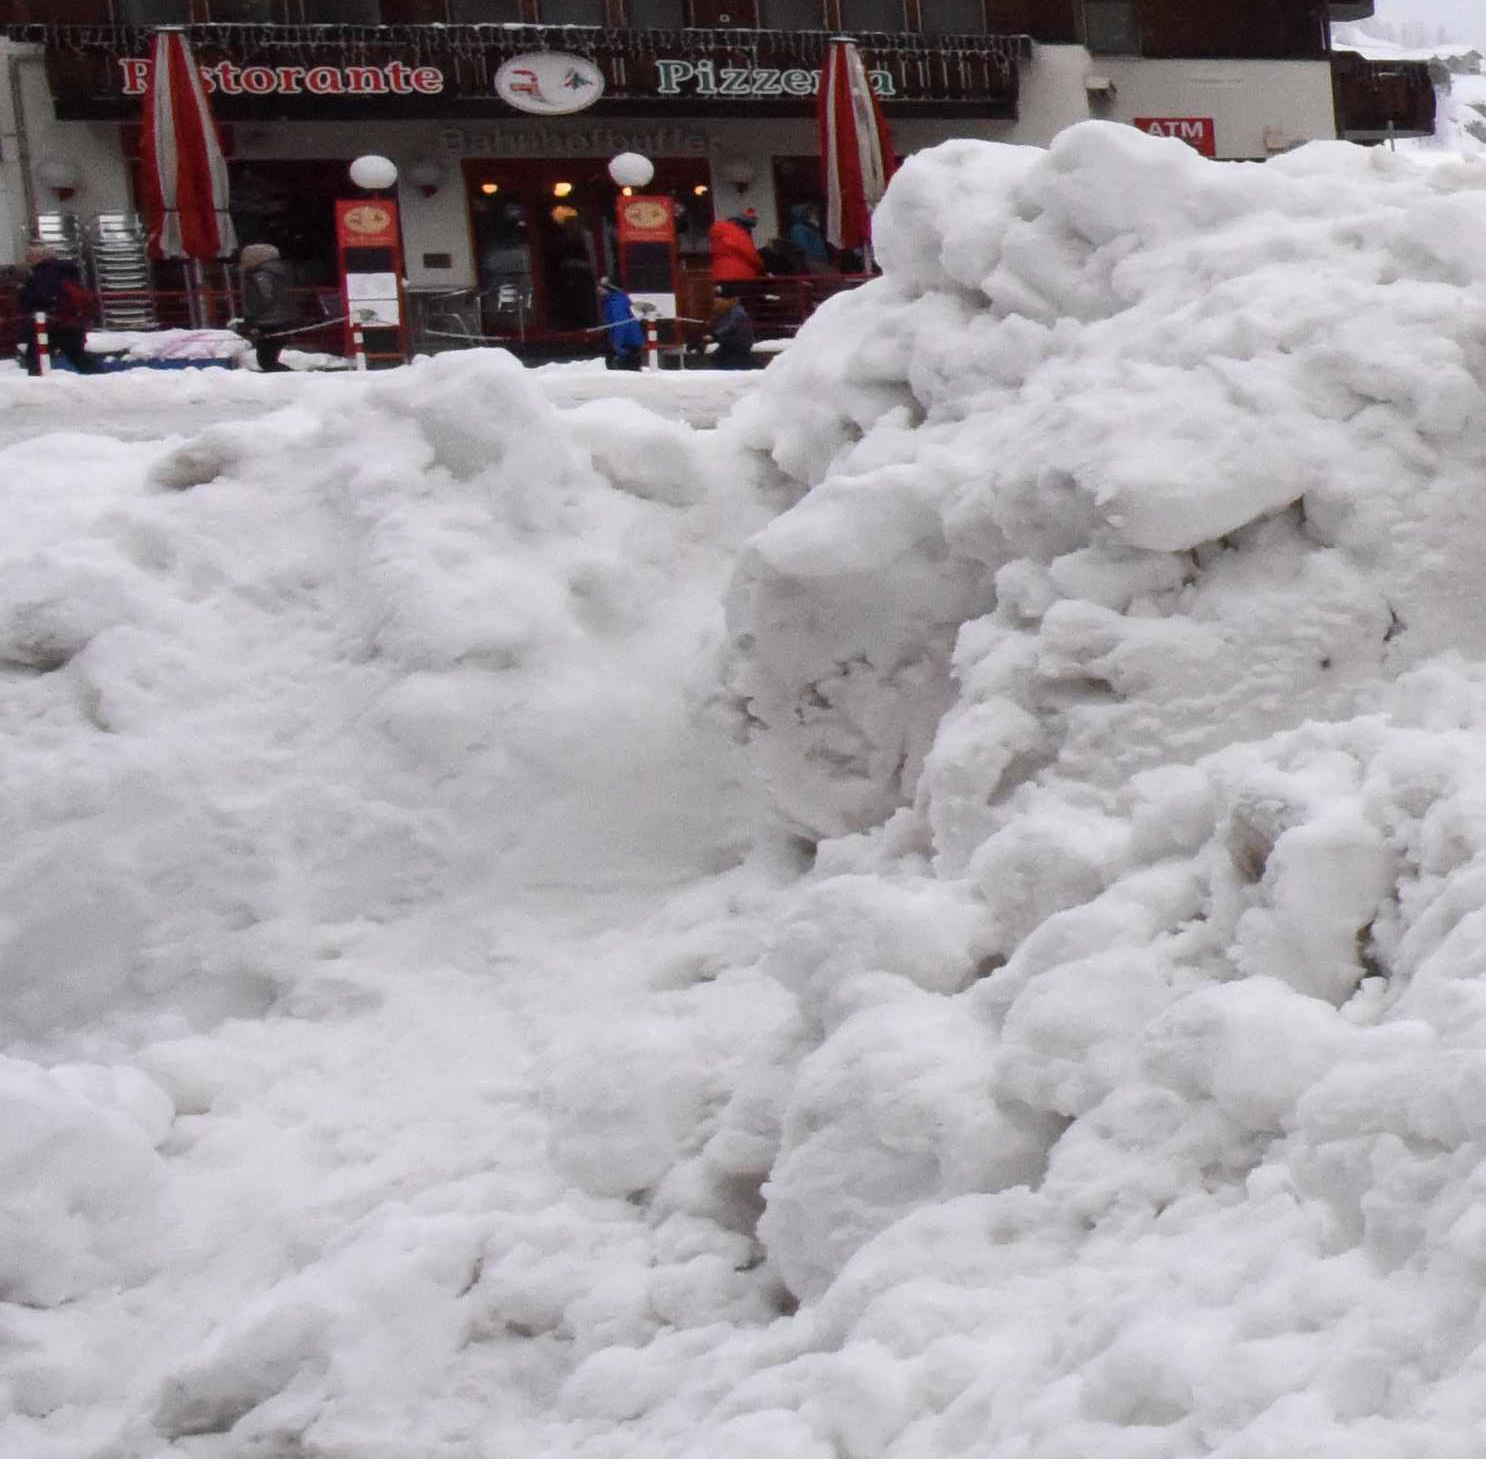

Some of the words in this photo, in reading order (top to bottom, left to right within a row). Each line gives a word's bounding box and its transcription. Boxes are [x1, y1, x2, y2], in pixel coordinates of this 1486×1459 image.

[119, 58, 444, 94] Rstorante
[655, 59, 897, 96] Pizzea
[1148, 121, 1204, 138] ATM
